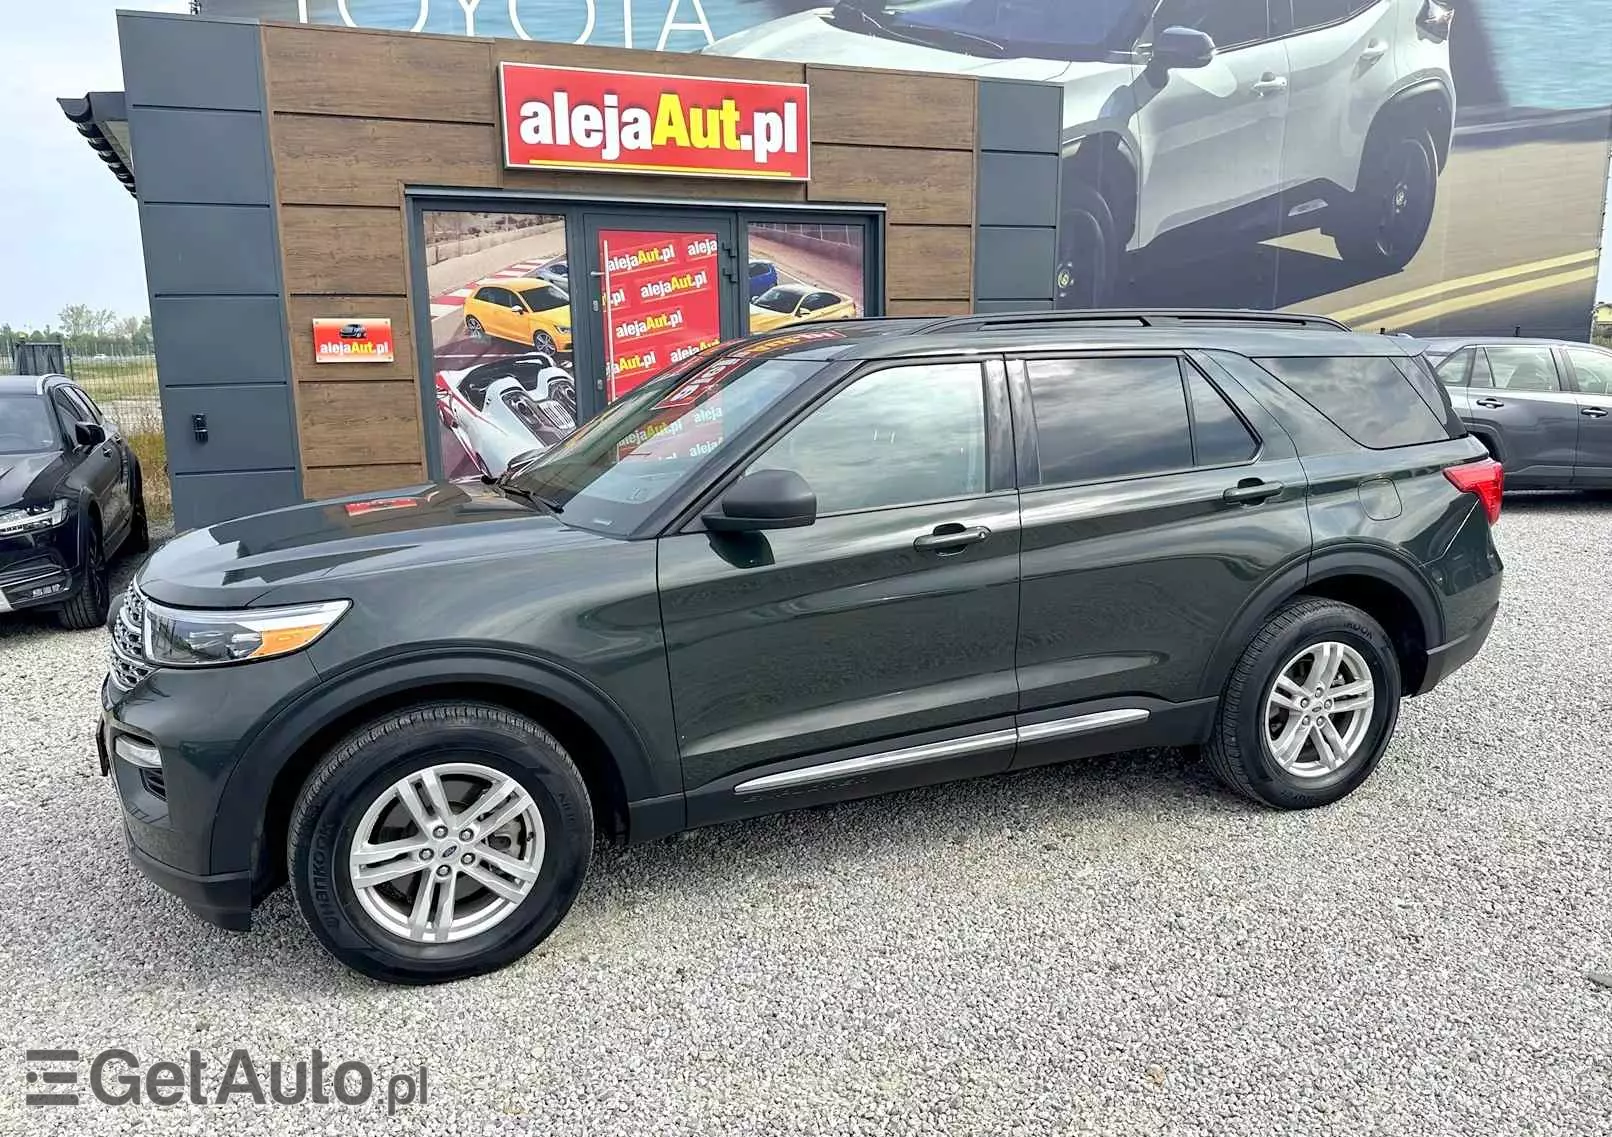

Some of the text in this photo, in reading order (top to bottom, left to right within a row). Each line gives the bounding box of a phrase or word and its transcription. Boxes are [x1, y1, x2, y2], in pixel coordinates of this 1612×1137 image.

[296, 0, 716, 51] OYOA
[519, 91, 799, 164] alejaAut.pl
[608, 244, 675, 272] alejaAut.pl
[687, 239, 718, 256] aleja
[640, 271, 707, 298] alejaAut.pl
[615, 310, 683, 339] alejaAut.pl
[320, 341, 389, 356] alejaAut.pl
